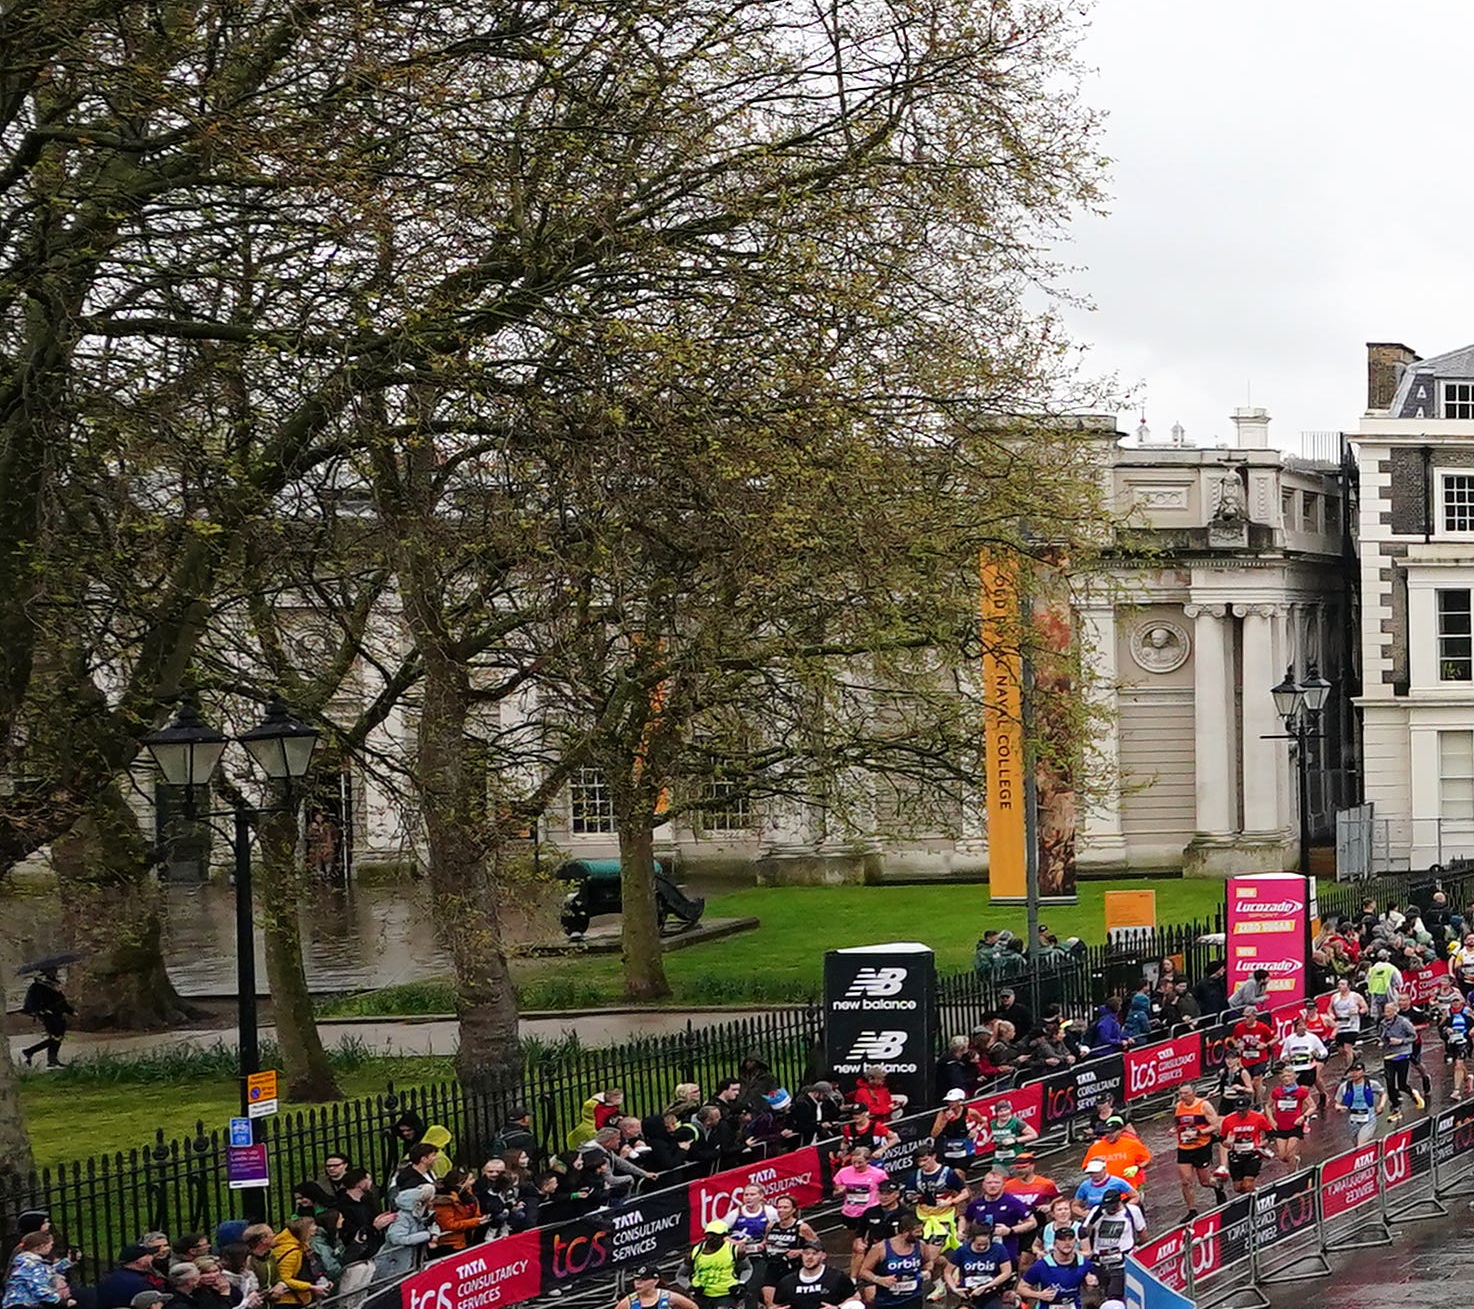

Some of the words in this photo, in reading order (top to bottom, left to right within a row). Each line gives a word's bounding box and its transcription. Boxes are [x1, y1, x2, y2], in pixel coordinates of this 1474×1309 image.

[996, 675, 1010, 729] NAVAL
[997, 735, 1012, 810] COLLEGE
[1235, 899, 1293, 915] Lucozade
[1235, 959, 1293, 974] Lucozade
[863, 999, 916, 1009] balance
[1076, 1072, 1096, 1085] TATA
[1129, 1057, 1158, 1091] tcs
[612, 1211, 681, 1245] CONSULTANCY
[613, 1211, 643, 1229] TATA
[551, 1229, 607, 1280] tcs
[612, 1237, 656, 1262] SERVICES
[456, 1258, 487, 1279] TATA
[888, 1258, 920, 1271] orbis
[964, 1261, 995, 1271] orbis
[456, 1258, 528, 1297] CONSULTANCY
